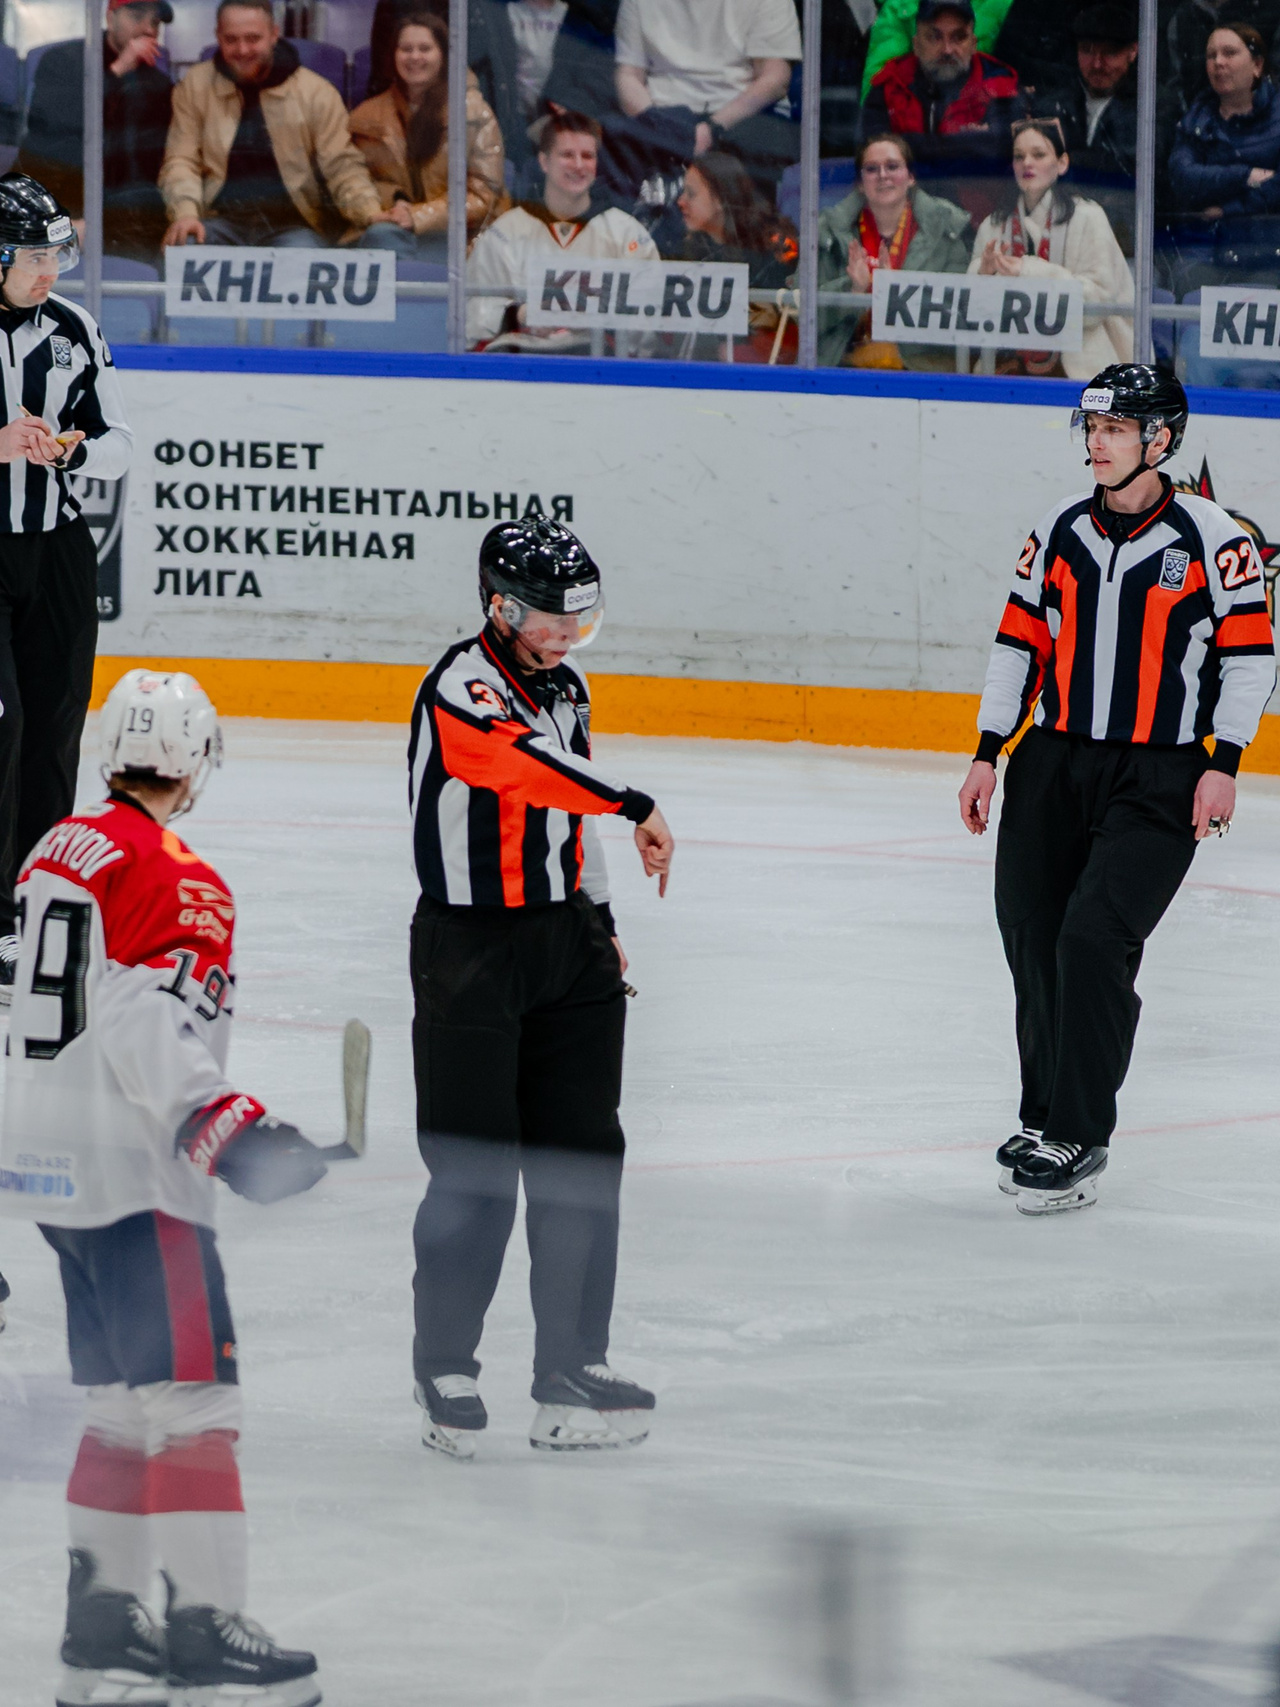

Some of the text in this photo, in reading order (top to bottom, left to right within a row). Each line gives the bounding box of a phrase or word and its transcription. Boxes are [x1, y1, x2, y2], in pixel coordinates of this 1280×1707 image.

[180, 260, 381, 306] KHL.RU
[539, 269, 734, 319] KHL.RU
[885, 283, 1069, 336] KHL.RU
[154, 439, 324, 471] ФОНБЕТ
[154, 481, 575, 523] КОНТИНЕНТАЛЬНАЯ
[154, 521, 416, 561] ХОККЕЙНАЯ
[154, 568, 263, 599] ЛИГА
[1217, 541, 1260, 589] 22
[127, 706, 154, 733] 19
[158, 948, 228, 1022] 19
[191, 1096, 255, 1173] AUER
